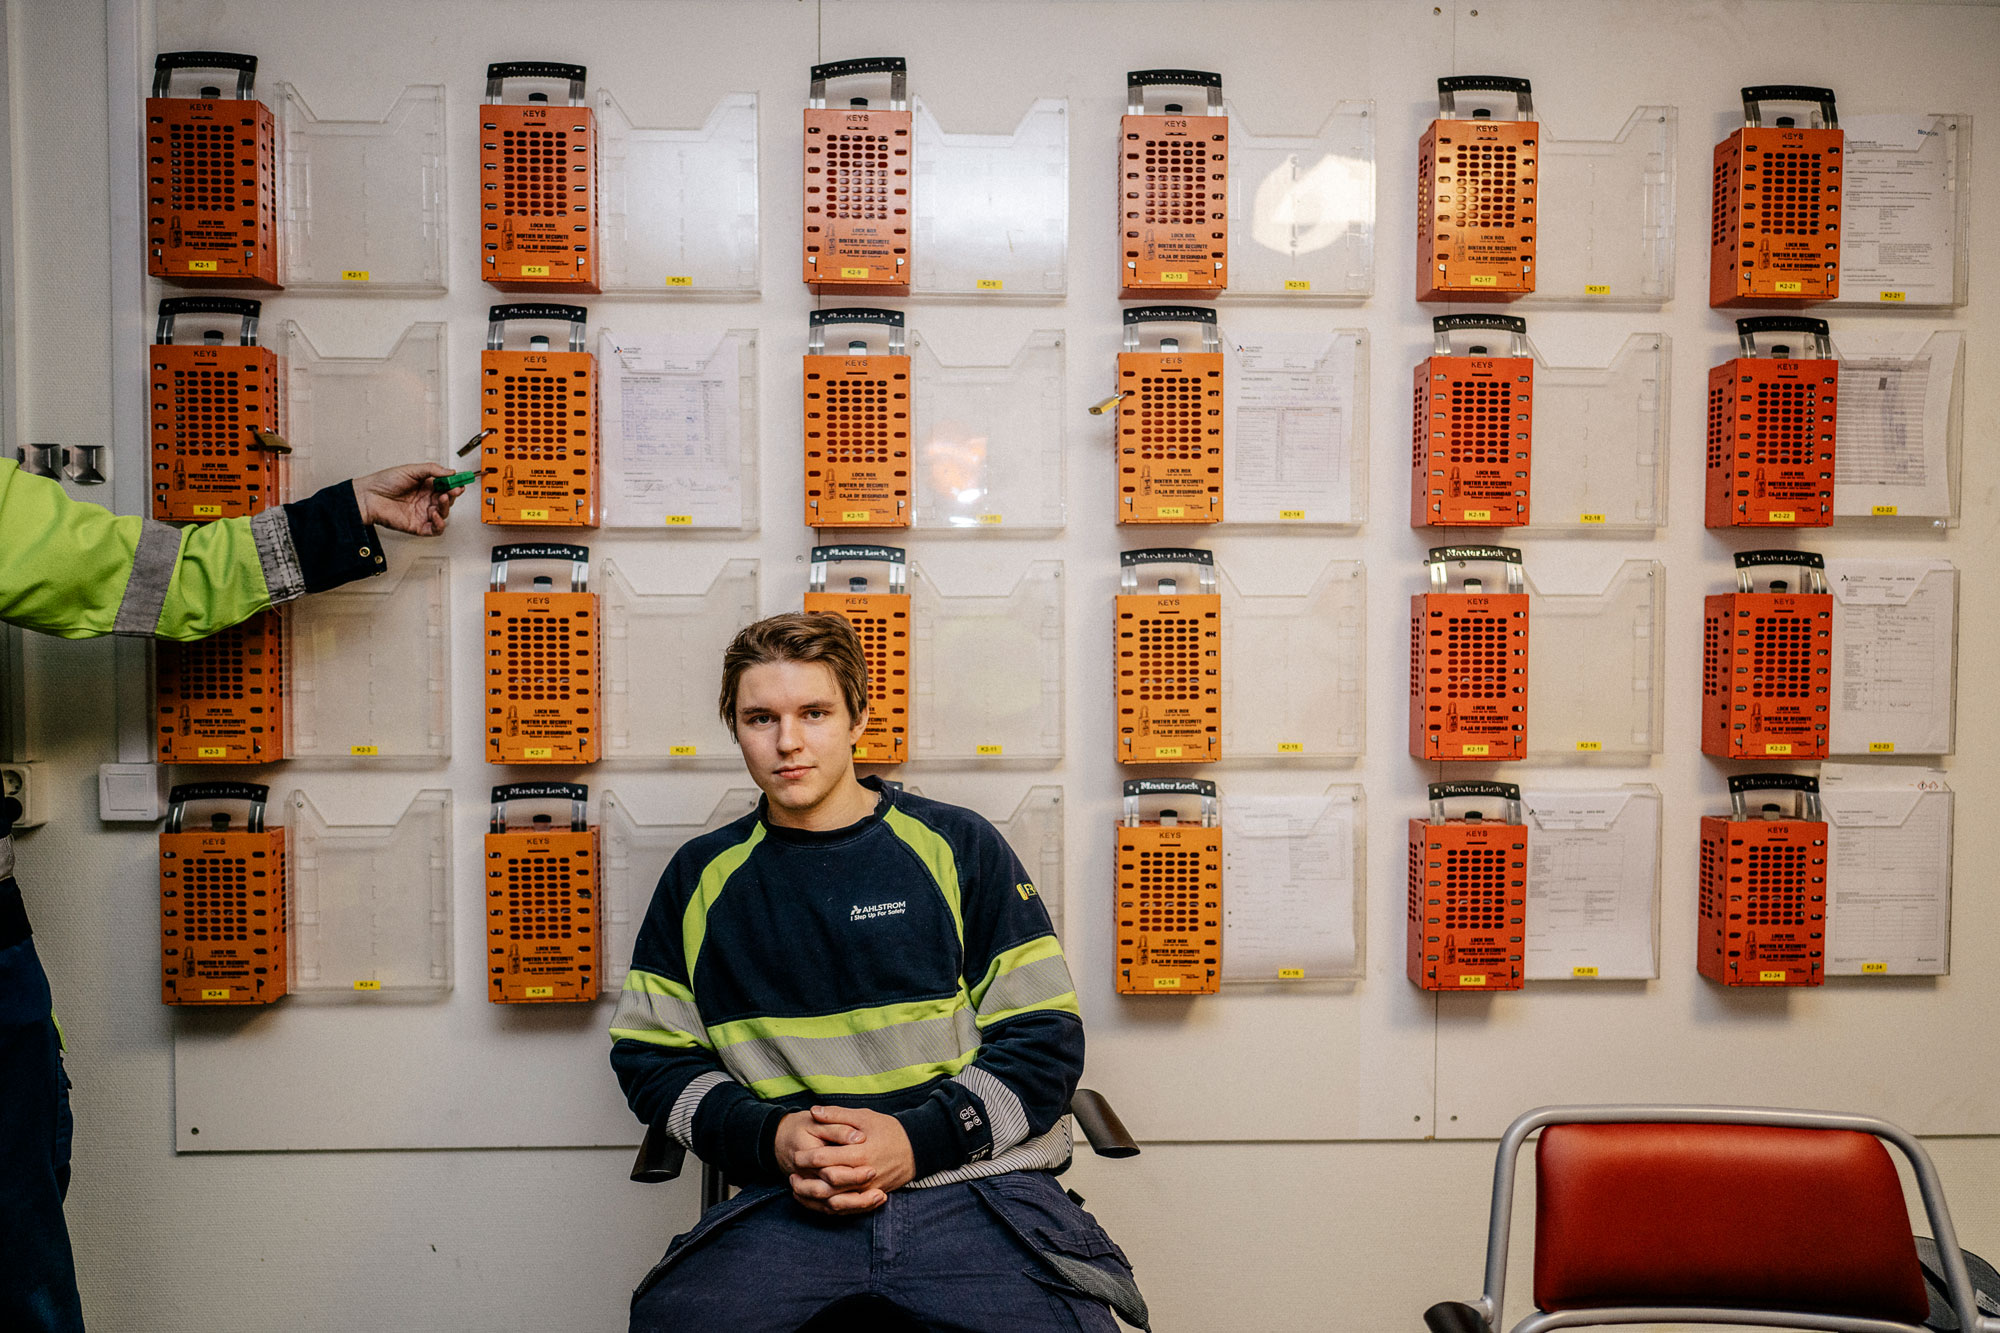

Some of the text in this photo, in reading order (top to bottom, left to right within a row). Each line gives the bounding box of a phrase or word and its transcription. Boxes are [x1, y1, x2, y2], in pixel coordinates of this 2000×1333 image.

[523, 109, 546, 117] KEYS
[1140, 782, 1198, 790] Master Lock
[862, 900, 906, 913] AHLSTROM
